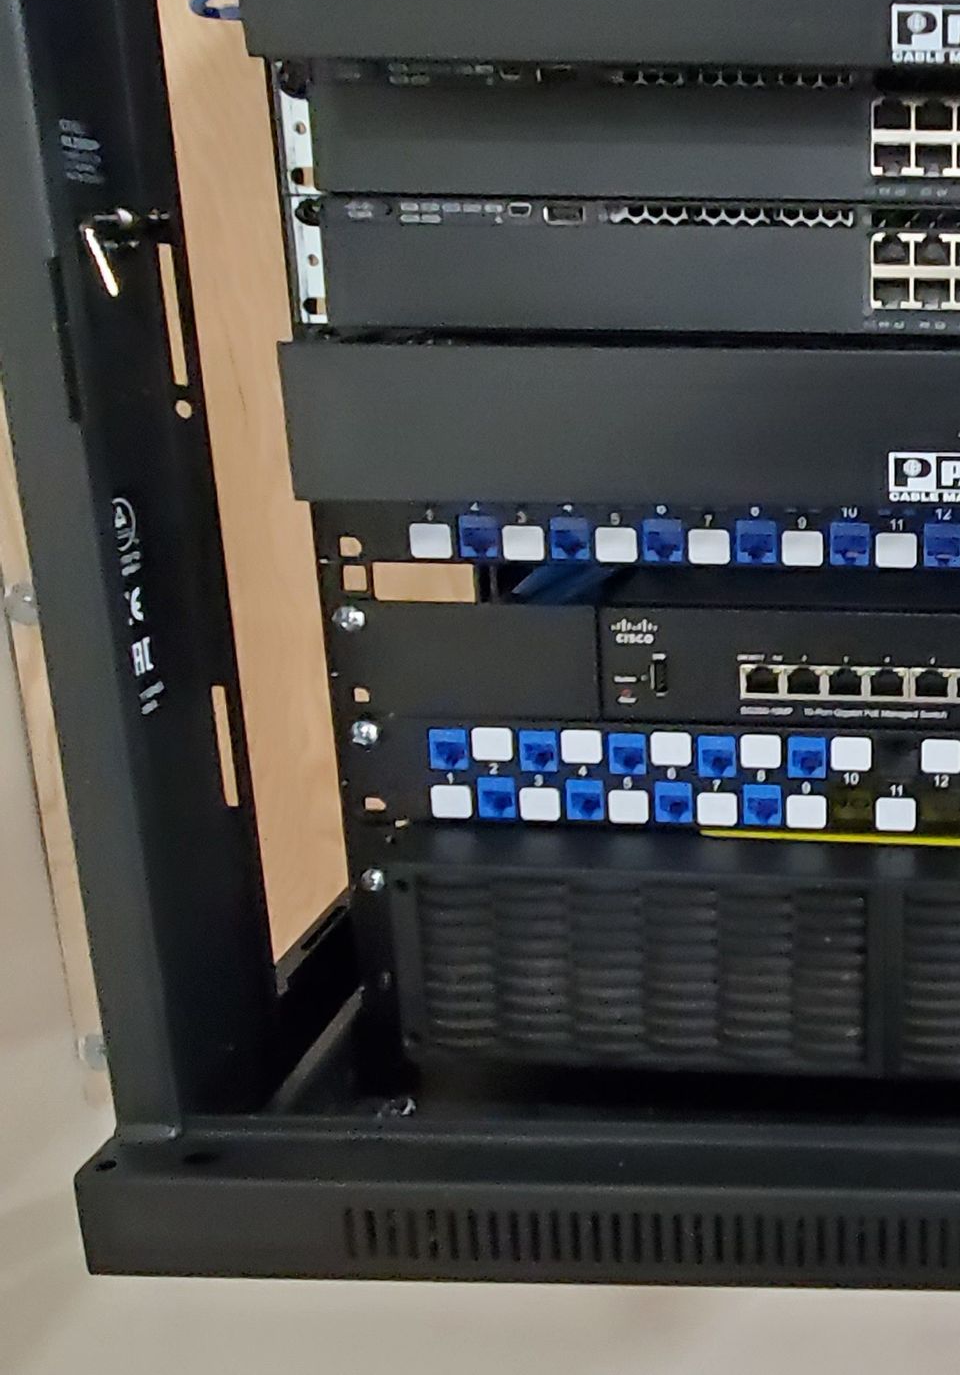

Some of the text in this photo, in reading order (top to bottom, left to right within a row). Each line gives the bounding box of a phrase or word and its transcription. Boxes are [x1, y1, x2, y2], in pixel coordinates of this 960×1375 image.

[892, 50, 944, 64] CABLE
[888, 492, 939, 503] CABLE
[889, 518, 904, 531] 11
[488, 762, 499, 775] 2
[578, 765, 588, 777] 4
[446, 772, 454, 785] 1
[622, 776, 633, 790] 5
[843, 772, 860, 785] 10
[934, 774, 950, 788] 12
[709, 779, 720, 793] 7
[889, 784, 903, 797] 11
